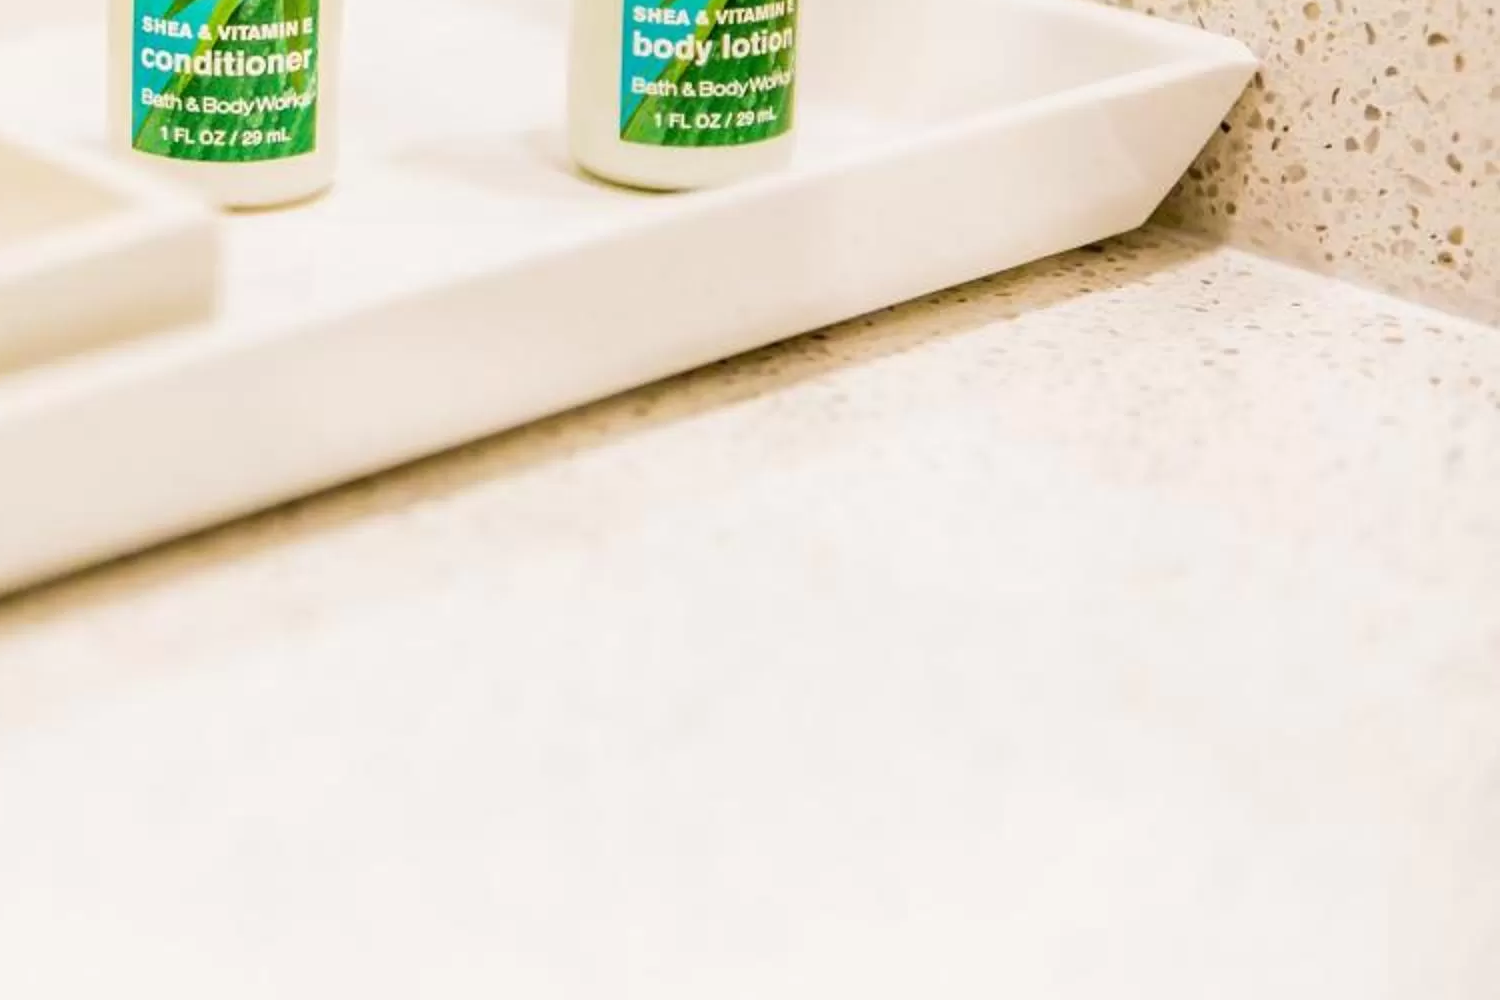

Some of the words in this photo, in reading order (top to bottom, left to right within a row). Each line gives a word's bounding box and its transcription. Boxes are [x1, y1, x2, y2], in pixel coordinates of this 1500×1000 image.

[632, 5, 691, 27] SHEA
[695, 10, 710, 26] &
[715, 0, 785, 25] VITAMIN
[141, 15, 193, 40] SHEA
[197, 24, 213, 41] &
[216, 19, 299, 41] VITAMIN
[302, 16, 314, 35] E
[632, 29, 713, 67] body
[721, 27, 794, 60] lotion
[140, 46, 313, 78] conditioner
[631, 76, 678, 97] Bath
[681, 81, 697, 98] &
[699, 78, 749, 98] Body
[140, 87, 182, 112] Bath
[185, 96, 200, 113] &
[203, 95, 254, 117] Body
[653, 112, 663, 129] 1
[668, 112, 693, 130] FL
[695, 113, 722, 130] OZ
[724, 112, 733, 129] /
[735, 110, 756, 127] 29
[756, 106, 778, 125] mL
[160, 125, 169, 141] 1
[173, 126, 195, 144] FL
[199, 128, 227, 147] OZ
[229, 129, 238, 147] /
[241, 129, 263, 147] 29
[266, 126, 293, 143] mL
